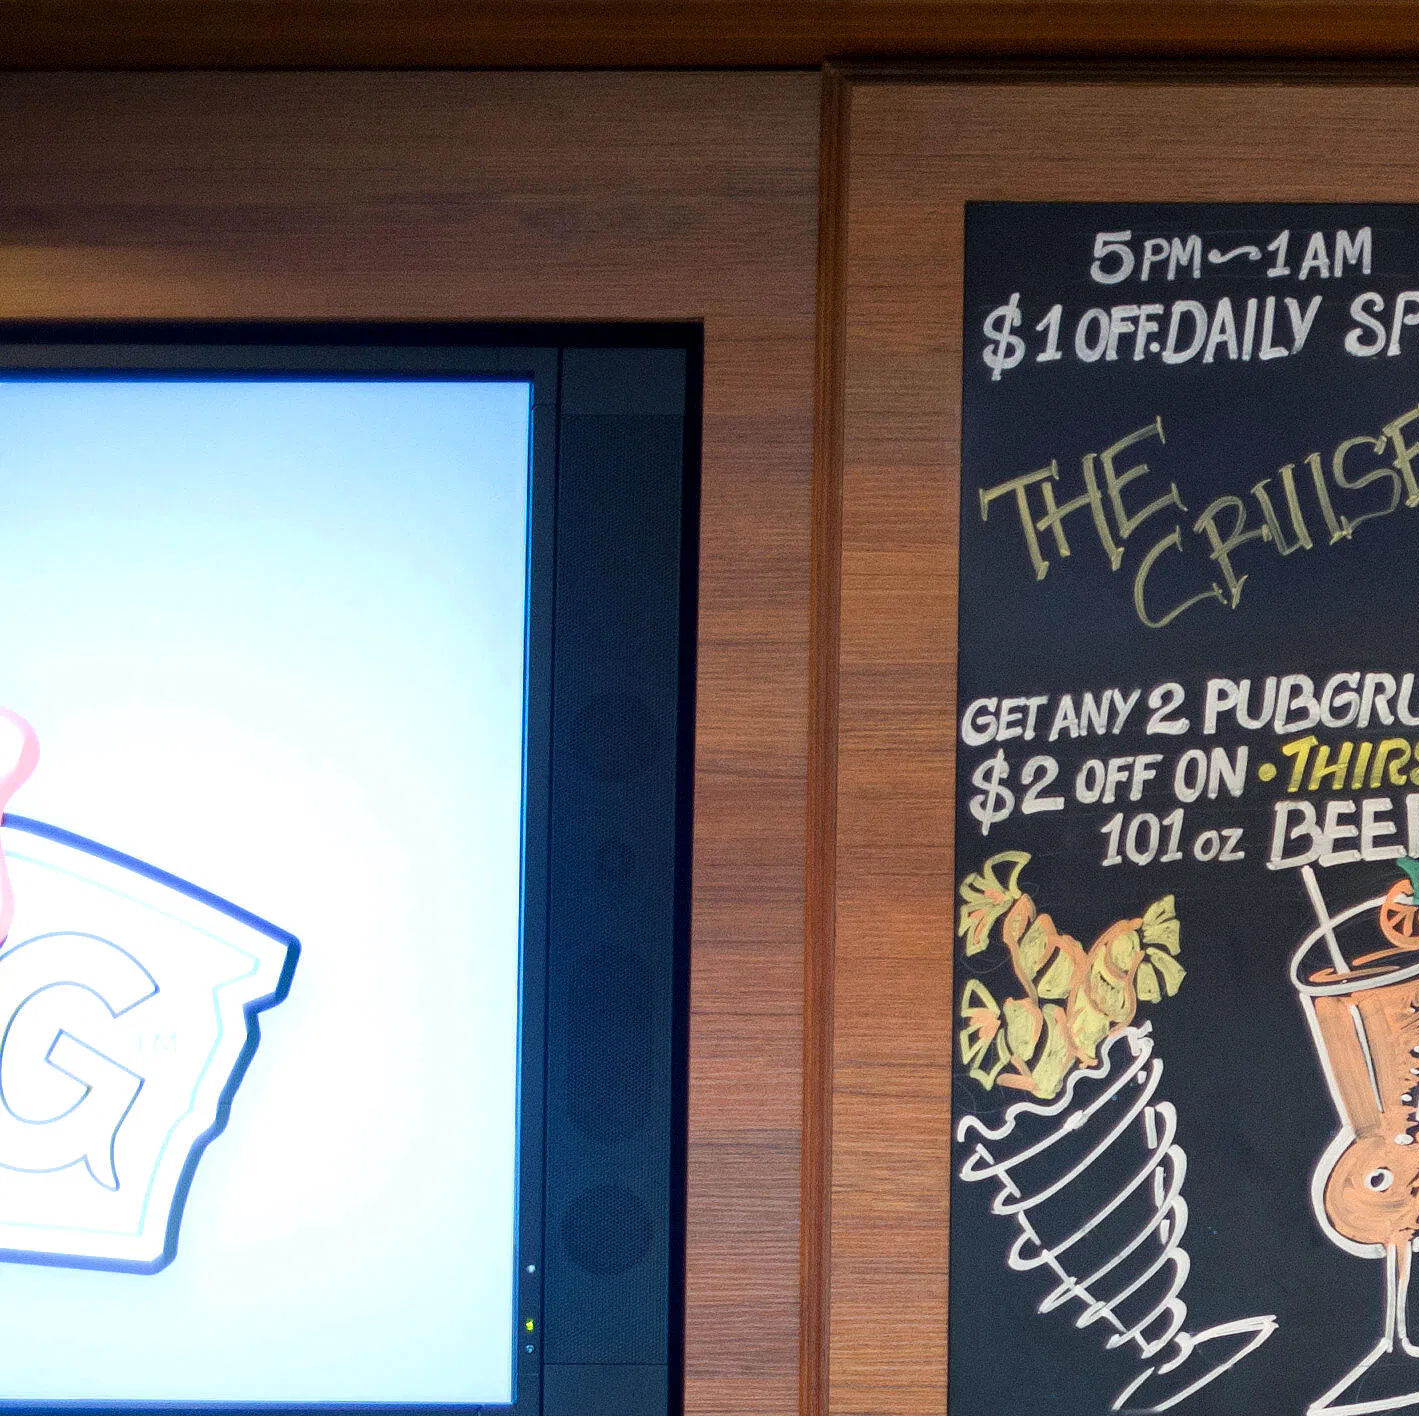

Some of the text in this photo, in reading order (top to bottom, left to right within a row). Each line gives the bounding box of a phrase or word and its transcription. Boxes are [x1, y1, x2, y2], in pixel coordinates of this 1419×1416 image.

[979, 415, 1187, 580] THE
[962, 697, 1043, 745] GET
[1048, 687, 1147, 741] ANY
[1147, 682, 1190, 735] 2
[1075, 753, 1163, 804] OFF
[1176, 747, 1249, 803] ON
[1100, 812, 1183, 867] 101
